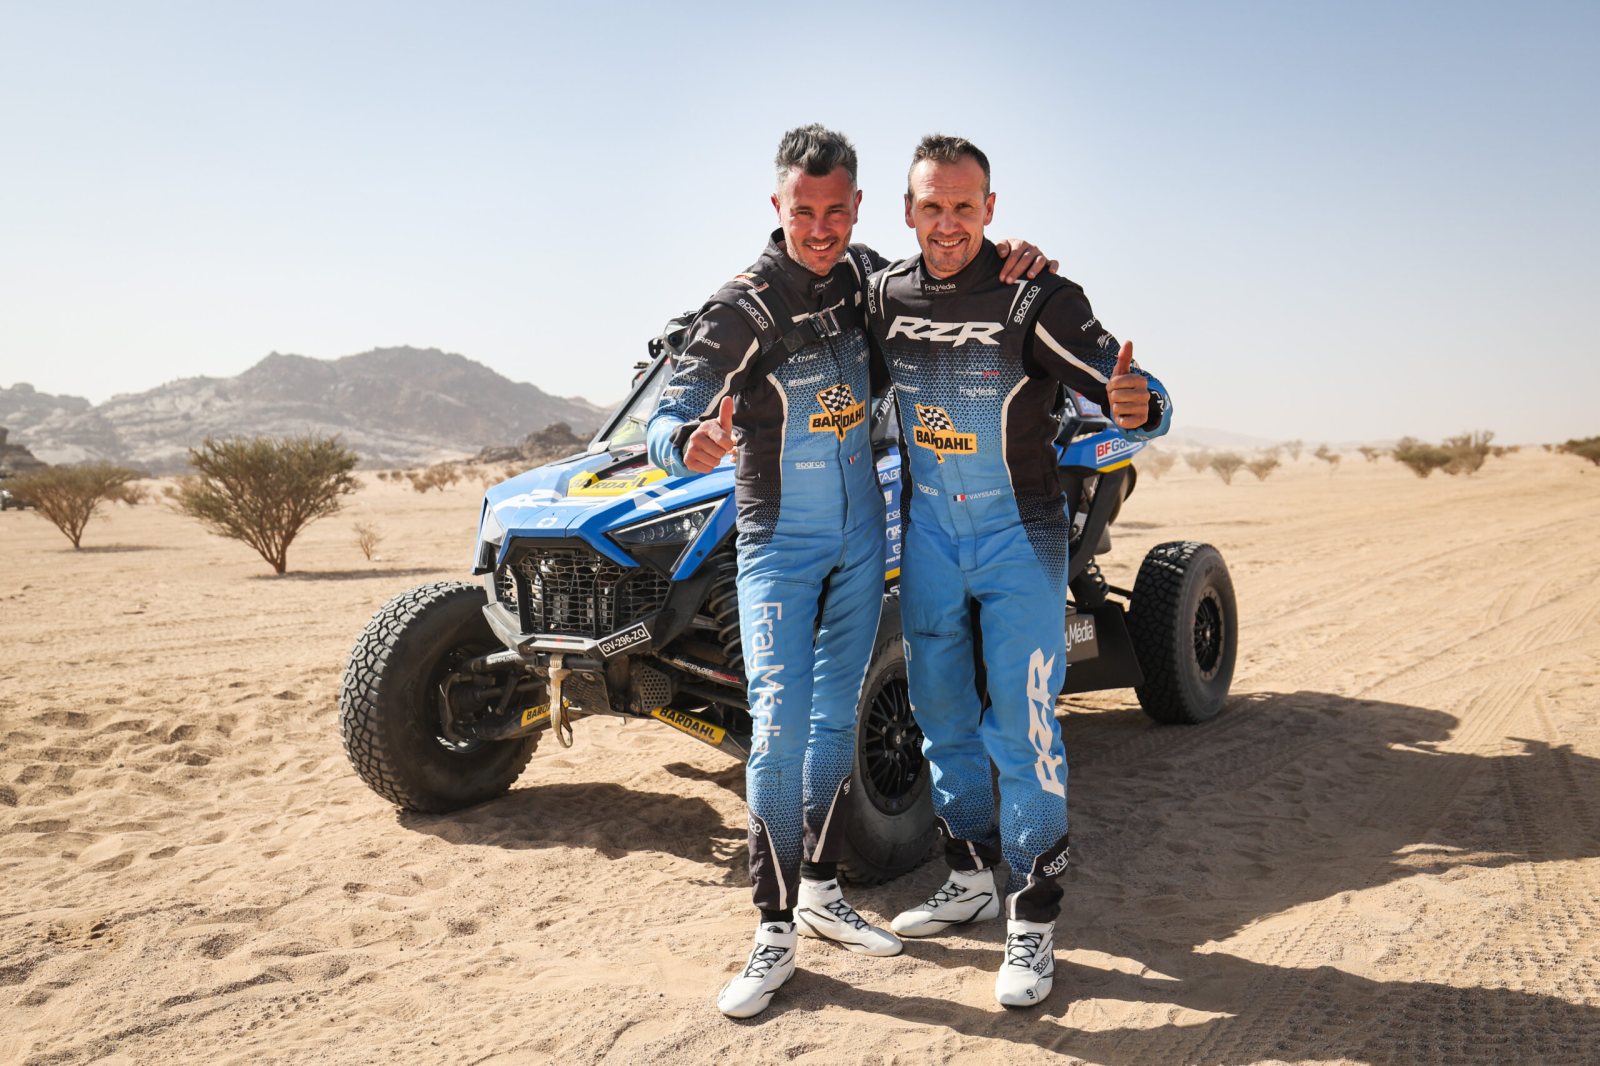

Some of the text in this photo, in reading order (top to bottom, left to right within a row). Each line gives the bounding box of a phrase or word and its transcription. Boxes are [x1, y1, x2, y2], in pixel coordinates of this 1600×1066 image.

[736, 298, 769, 331] sparco
[1013, 284, 1041, 325] sparco
[696, 335, 720, 349] ARIS
[885, 315, 1004, 347] RZR
[813, 406, 864, 429] BARDAHL
[602, 627, 648, 653] GV-296-ZQ
[659, 706, 717, 741] BARDAHL
[1027, 648, 1065, 798] RZR
[1042, 846, 1070, 877] spar
